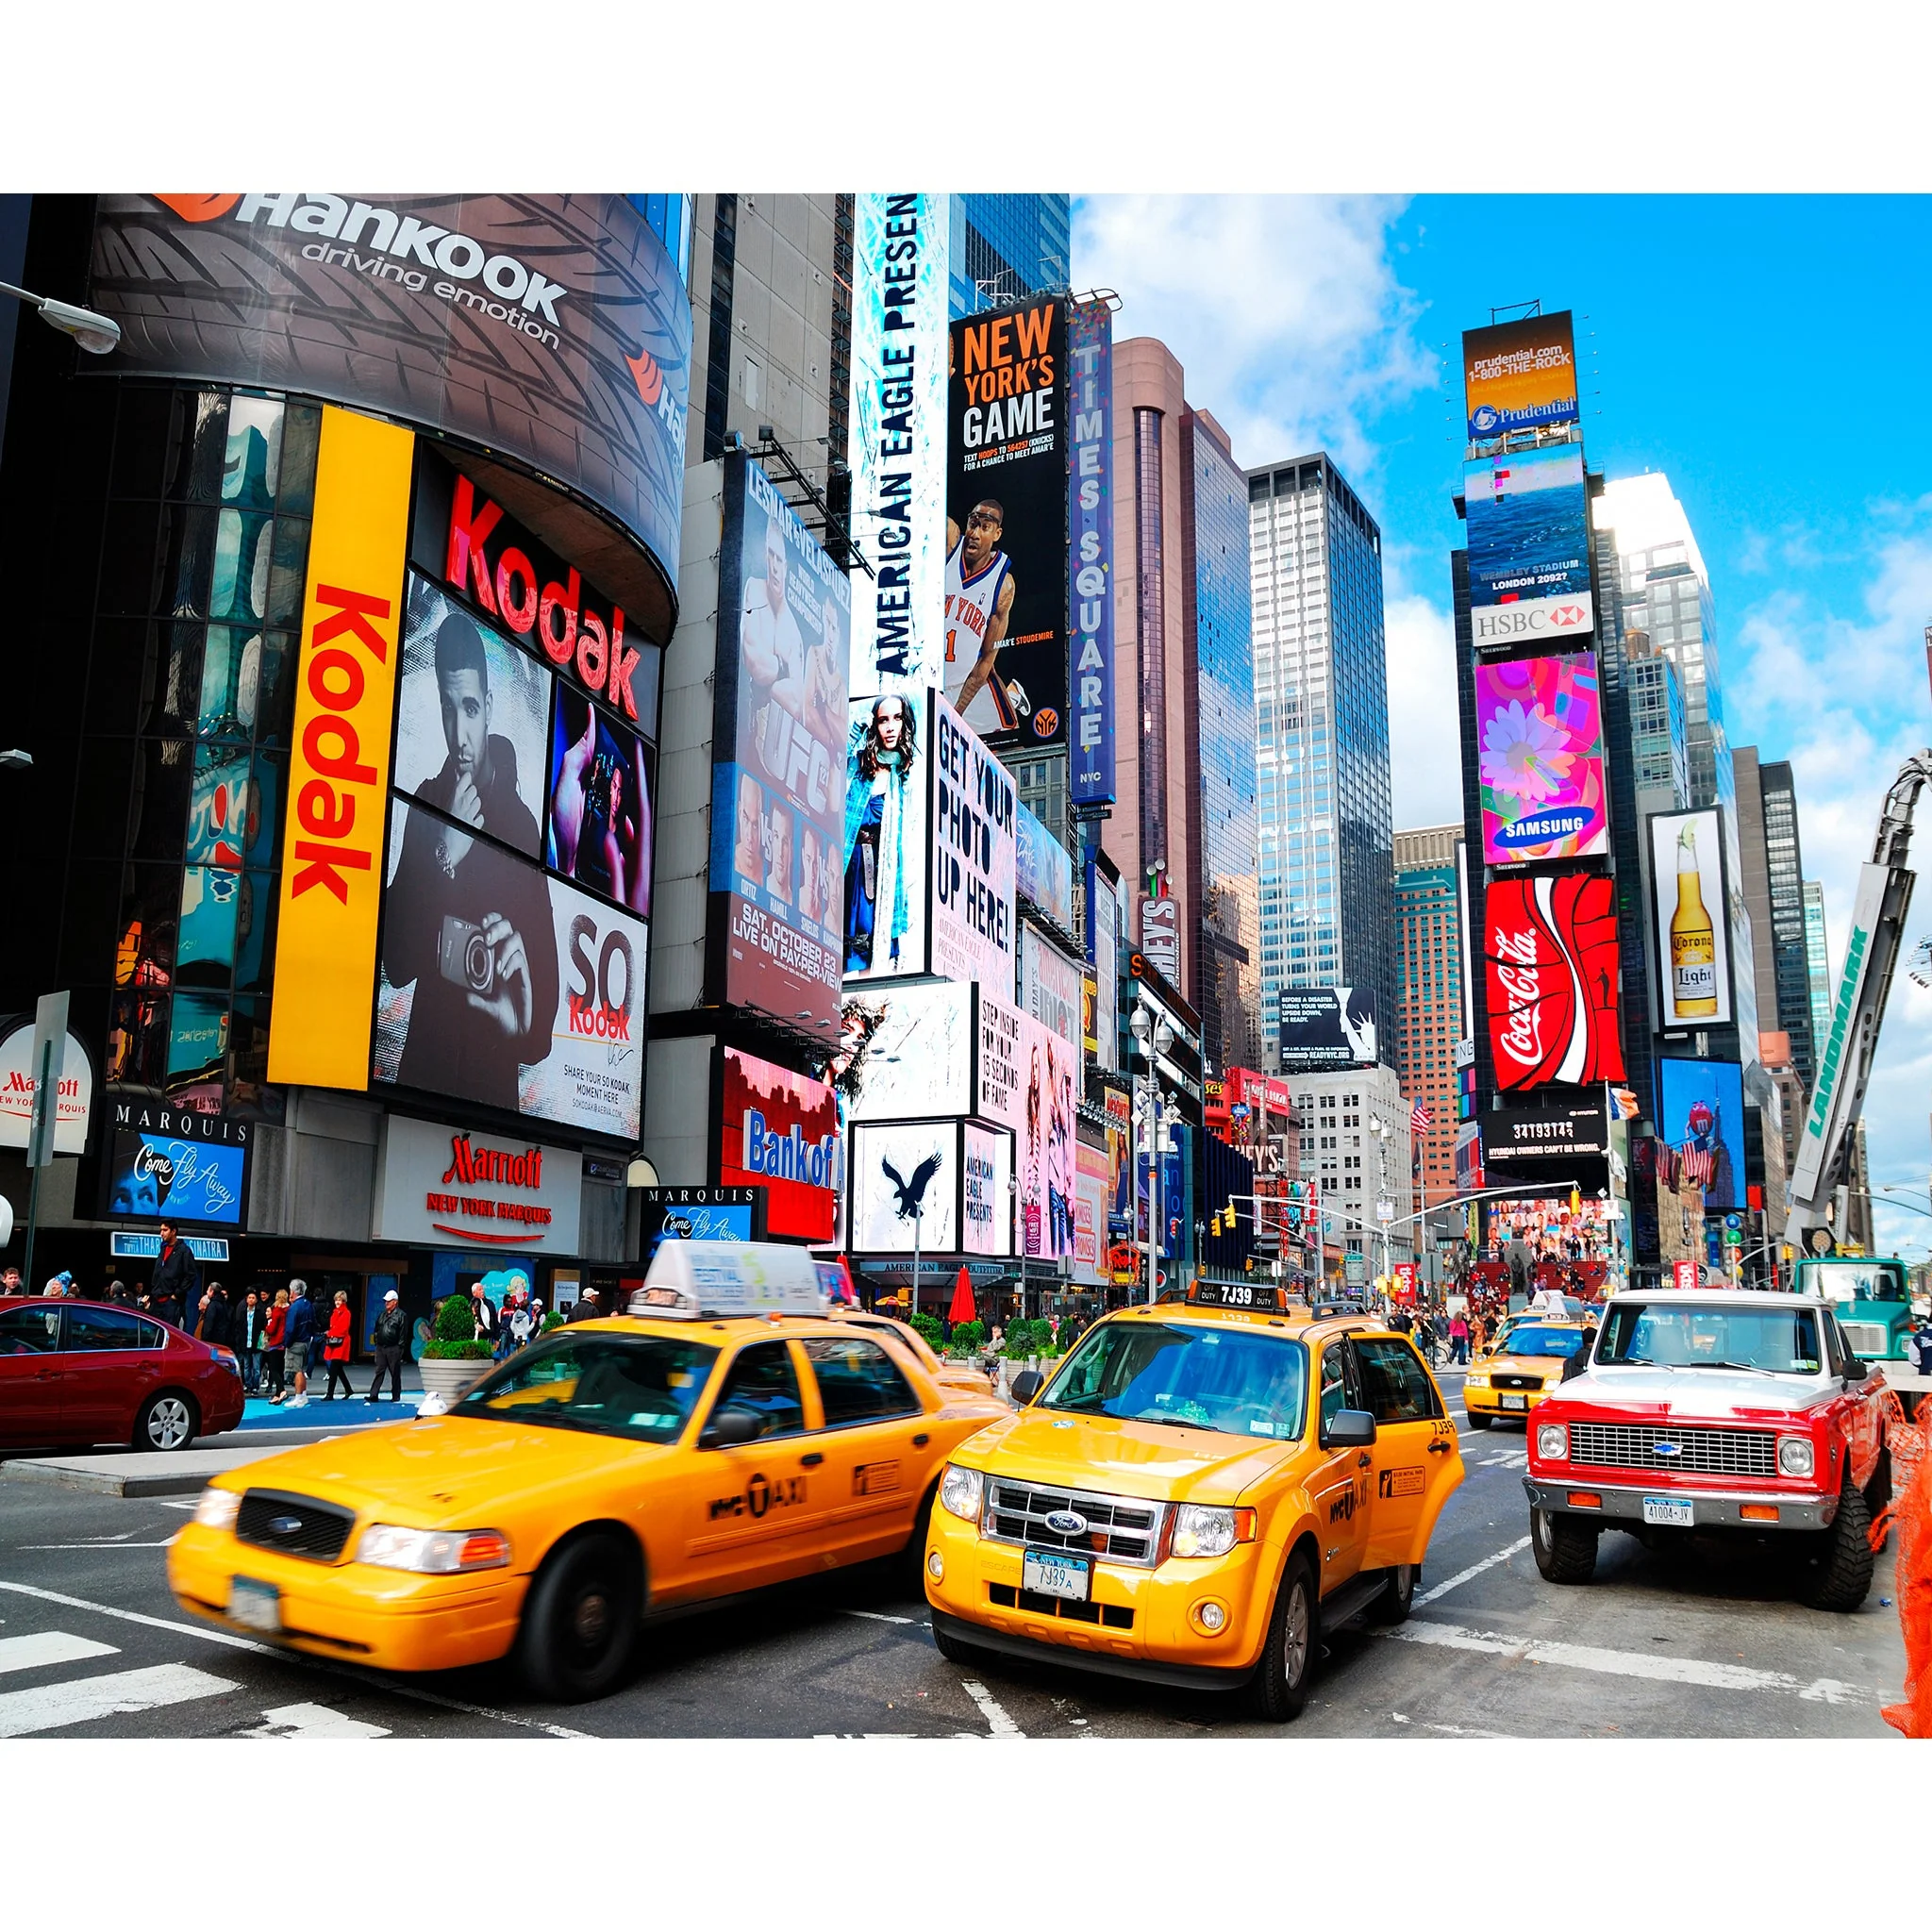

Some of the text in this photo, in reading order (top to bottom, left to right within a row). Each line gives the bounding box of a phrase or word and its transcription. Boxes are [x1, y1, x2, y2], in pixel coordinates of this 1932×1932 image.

[301, 242, 560, 351] driving emotion
[963, 303, 1055, 375] NEW
[1468, 353, 1571, 382] 1-800-THE-ROCK
[1474, 345, 1563, 373] prudential.com
[964, 355, 1055, 408] YORK'S
[880, 344, 916, 458] EAGLE
[1500, 396, 1575, 424] Prudential
[963, 386, 1055, 448] GAME
[963, 441, 1055, 472] FOR A CHANCE TO MEET AMAR'E
[964, 453, 978, 463] TEXT
[978, 447, 997, 460] HOOPS
[998, 446, 1007, 455] TO
[748, 460, 793, 544] LESNAR
[1074, 342, 1107, 747] TIMES SQUARE
[875, 473, 912, 676] AMERICAN
[1479, 558, 1579, 581] WEMBLEY STADIUM
[1492, 572, 1568, 591] LONDON 2092?
[445, 473, 641, 722] Kodak
[956, 596, 987, 639] YORK
[1478, 609, 1546, 638] HSBC
[1015, 630, 1055, 645] STOUDEMIRE
[291, 583, 391, 907] Kodak
[762, 698, 831, 815] UFC
[939, 713, 969, 791] GET
[974, 750, 1013, 839] YOUR
[1080, 771, 1102, 785] NYC
[938, 777, 991, 876] PHOTO
[1506, 817, 1584, 838] SAMSUNG
[938, 845, 1009, 955] UP HERE!
[733, 917, 758, 947] LIVE
[761, 932, 778, 958] ON
[742, 903, 769, 934] SAT.
[772, 921, 823, 964] OCTOBER
[824, 951, 837, 974] 23
[1674, 936, 1712, 951] Corona
[568, 913, 637, 1019] SO
[1678, 968, 1711, 986] Light
[569, 995, 631, 1041] Kodak
[982, 1000, 1019, 1041] STEP INSIDE
[1808, 924, 1868, 1140] LANDMARK
[982, 1025, 1011, 1062] FOR YOUR
[3, 1071, 78, 1096] Maott
[564, 1064, 631, 1094] SHARE YOUR SO KODAK
[983, 1054, 1019, 1091] 15 SECONDS
[1205, 1081, 1224, 1095] se's
[58, 1103, 86, 1114] RQUIS
[576, 1083, 619, 1105] MOMENT HERE
[982, 1080, 1008, 1111] OF FAME
[115, 1104, 247, 1141] MARQUIS
[441, 1135, 542, 1190] Marriott
[742, 1108, 808, 1185] Bank
[807, 1134, 834, 1188] of
[1489, 1147, 1516, 1156] HYUNDAI
[1516, 1145, 1543, 1155] OWNERS
[1544, 1144, 1564, 1154] CAN'T
[1564, 1143, 1574, 1153] BE
[134, 1141, 236, 1214] Come Fly Away
[966, 1157, 993, 1180] AMERICAN
[649, 1189, 754, 1203] MARQUIS
[966, 1177, 982, 1200] EAGLE
[426, 1192, 552, 1225] NEW YORK MARQUIS
[662, 1211, 691, 1237] Come
[681, 1208, 711, 1239] Fly
[966, 1200, 992, 1224] PRESENTS
[139, 1237, 161, 1255] THAR
[189, 1240, 223, 1258] SINATRA
[938, 1263, 960, 1273] EAGL
[1221, 1286, 1252, 1305] 7J39
[1430, 1421, 1456, 1437] 7J39
[1054, 1515, 1074, 1529] Ford
[981, 1559, 1022, 1575] ESCAPE
[1041, 1557, 1055, 1567] NEW
